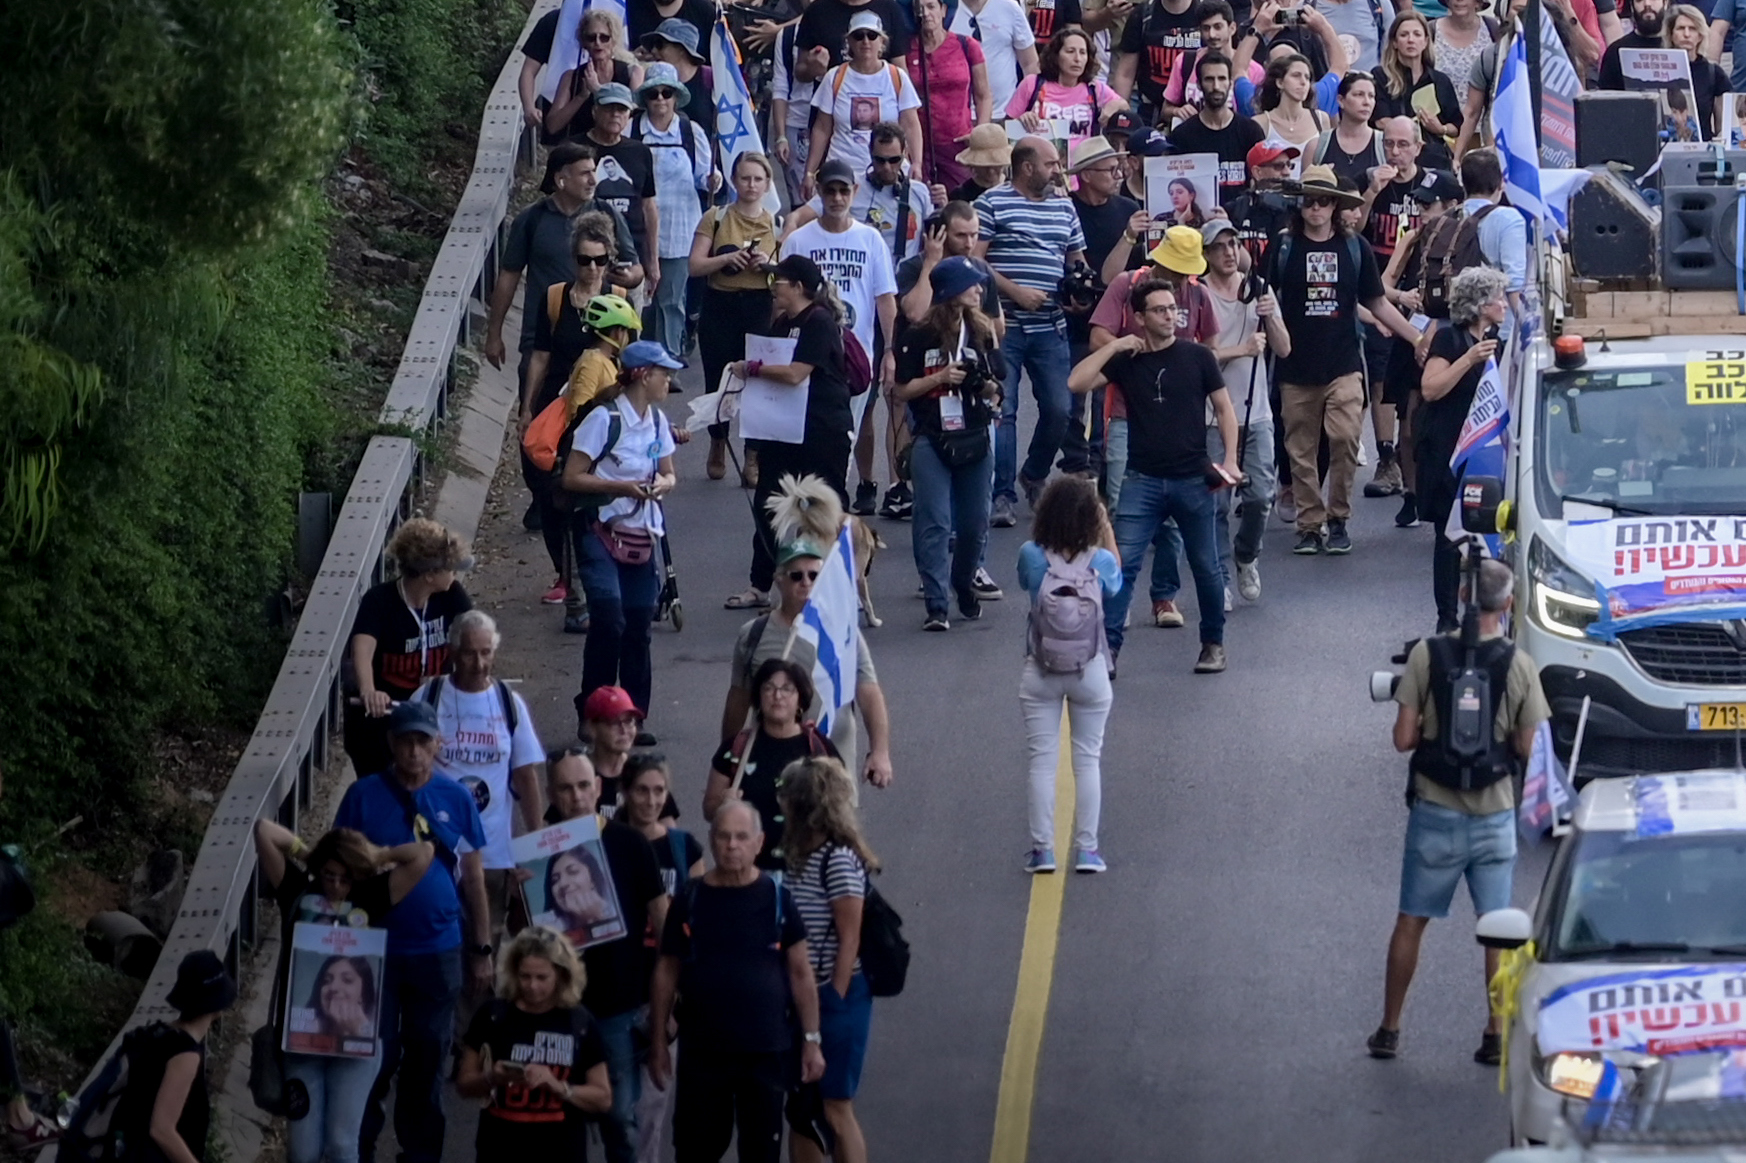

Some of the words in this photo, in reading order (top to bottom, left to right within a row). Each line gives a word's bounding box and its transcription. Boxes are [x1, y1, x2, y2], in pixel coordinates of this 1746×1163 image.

[810, 249, 827, 262] את
[829, 248, 866, 264] תחזירו
[1614, 519, 1717, 547] אותם
[1588, 980, 1703, 1013] אותם
[1588, 1002, 1741, 1046] עכשיו!
